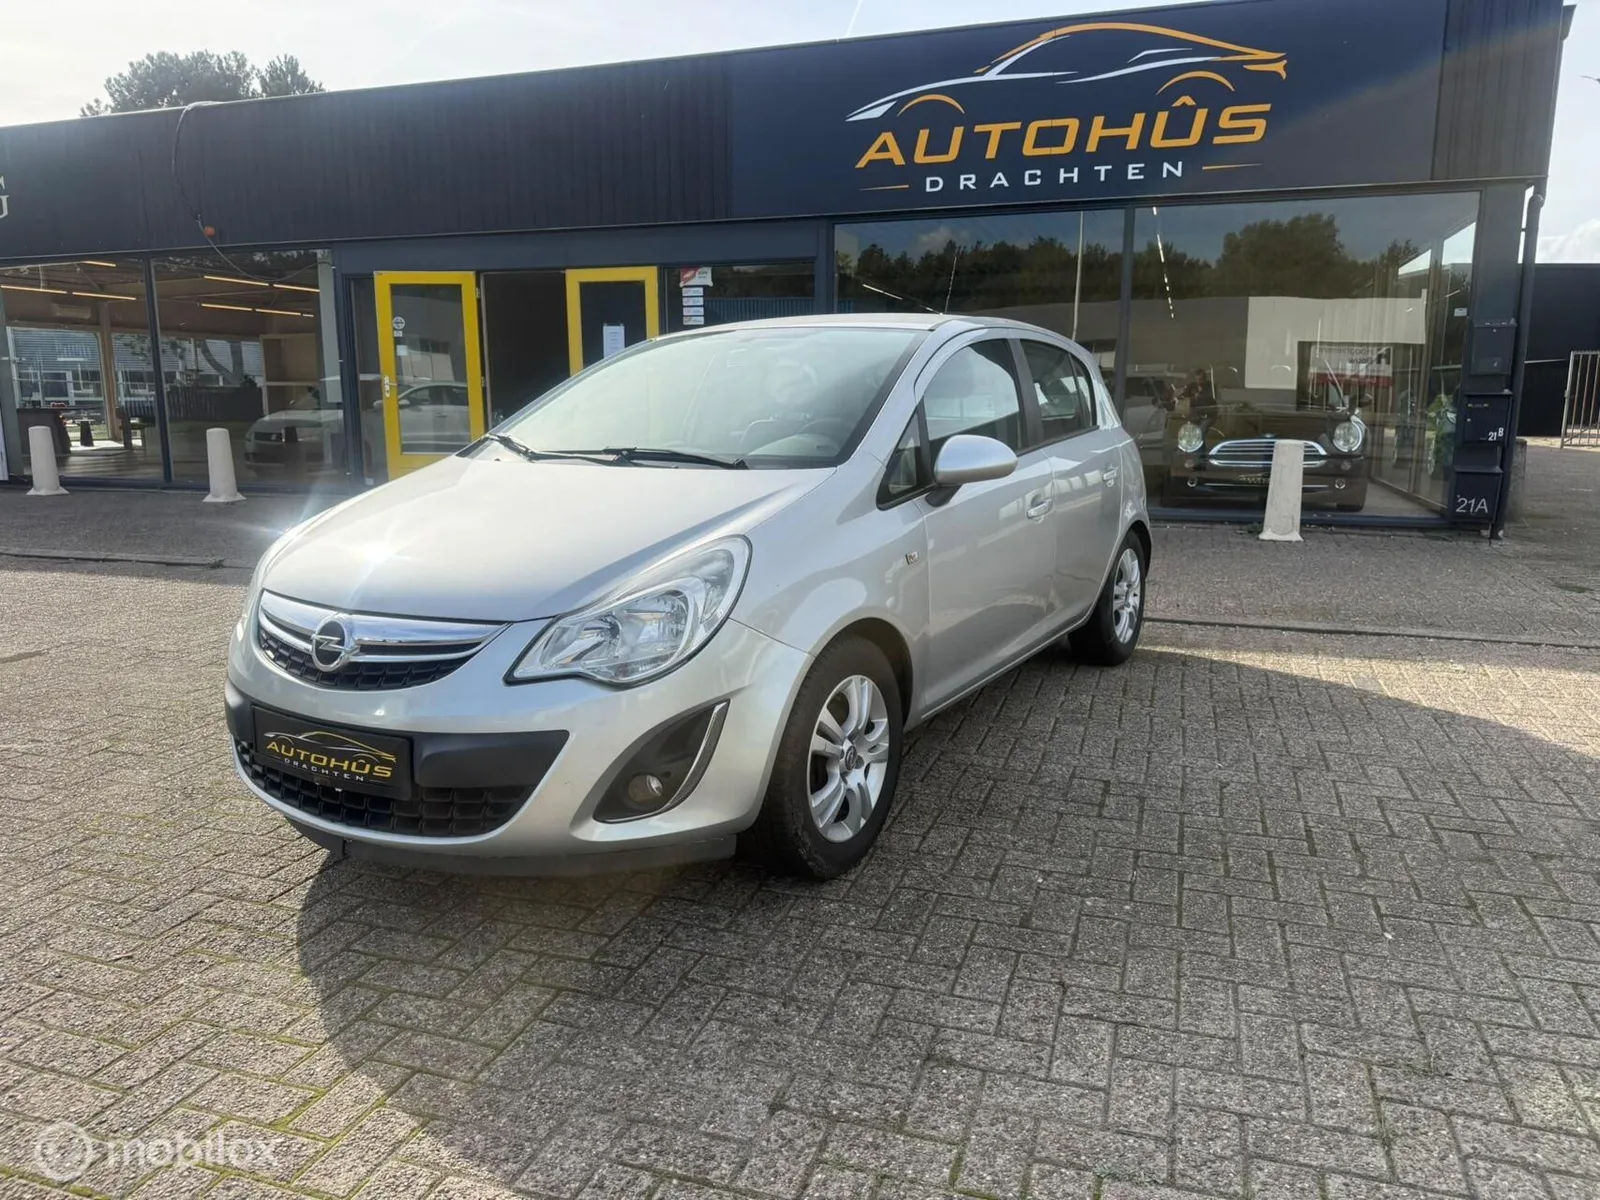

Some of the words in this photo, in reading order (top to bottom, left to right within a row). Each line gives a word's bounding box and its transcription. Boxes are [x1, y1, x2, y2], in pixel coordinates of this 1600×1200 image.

[855, 95, 1272, 168] AUTOHÛS
[924, 161, 1184, 193] DRACHTEN
[1455, 497, 1488, 514] 21A
[266, 741, 393, 778] AUTOHÛS
[284, 758, 364, 782] DRACHTEN
